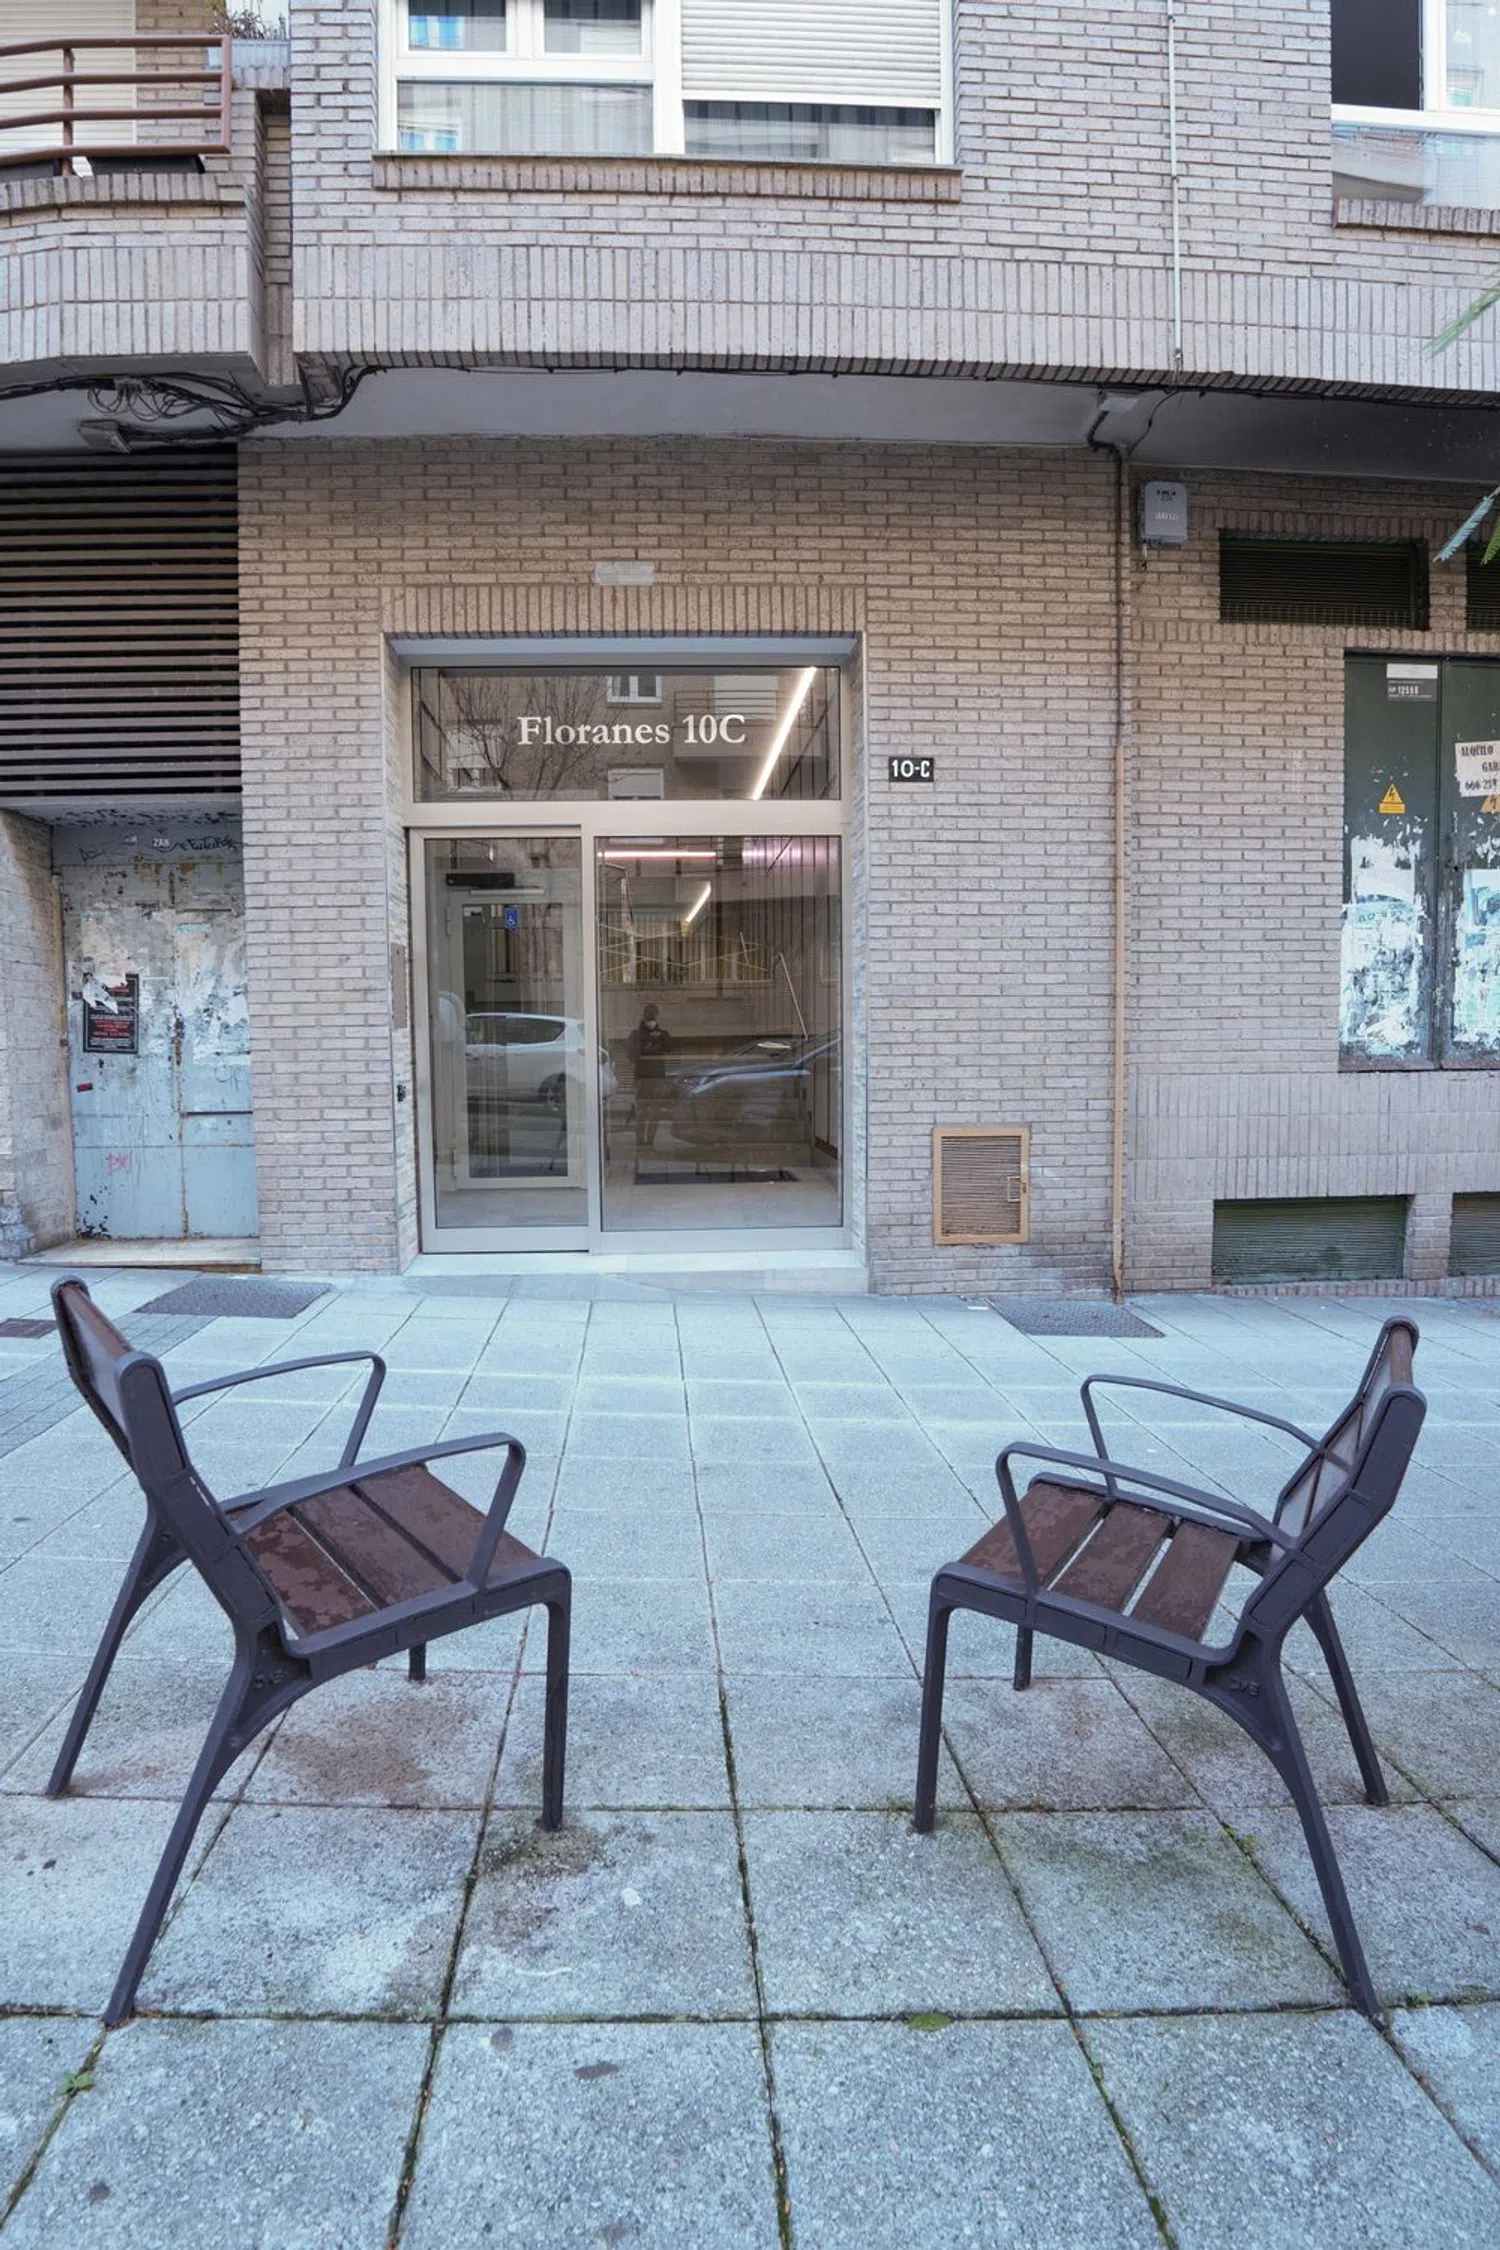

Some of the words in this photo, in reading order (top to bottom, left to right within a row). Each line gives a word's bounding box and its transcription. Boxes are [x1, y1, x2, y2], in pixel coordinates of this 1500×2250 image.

[517, 716, 670, 745] Floranes
[682, 714, 747, 744] 10C
[1461, 745, 1493, 757] ALQUILO
[892, 760, 930, 778] 10-C
